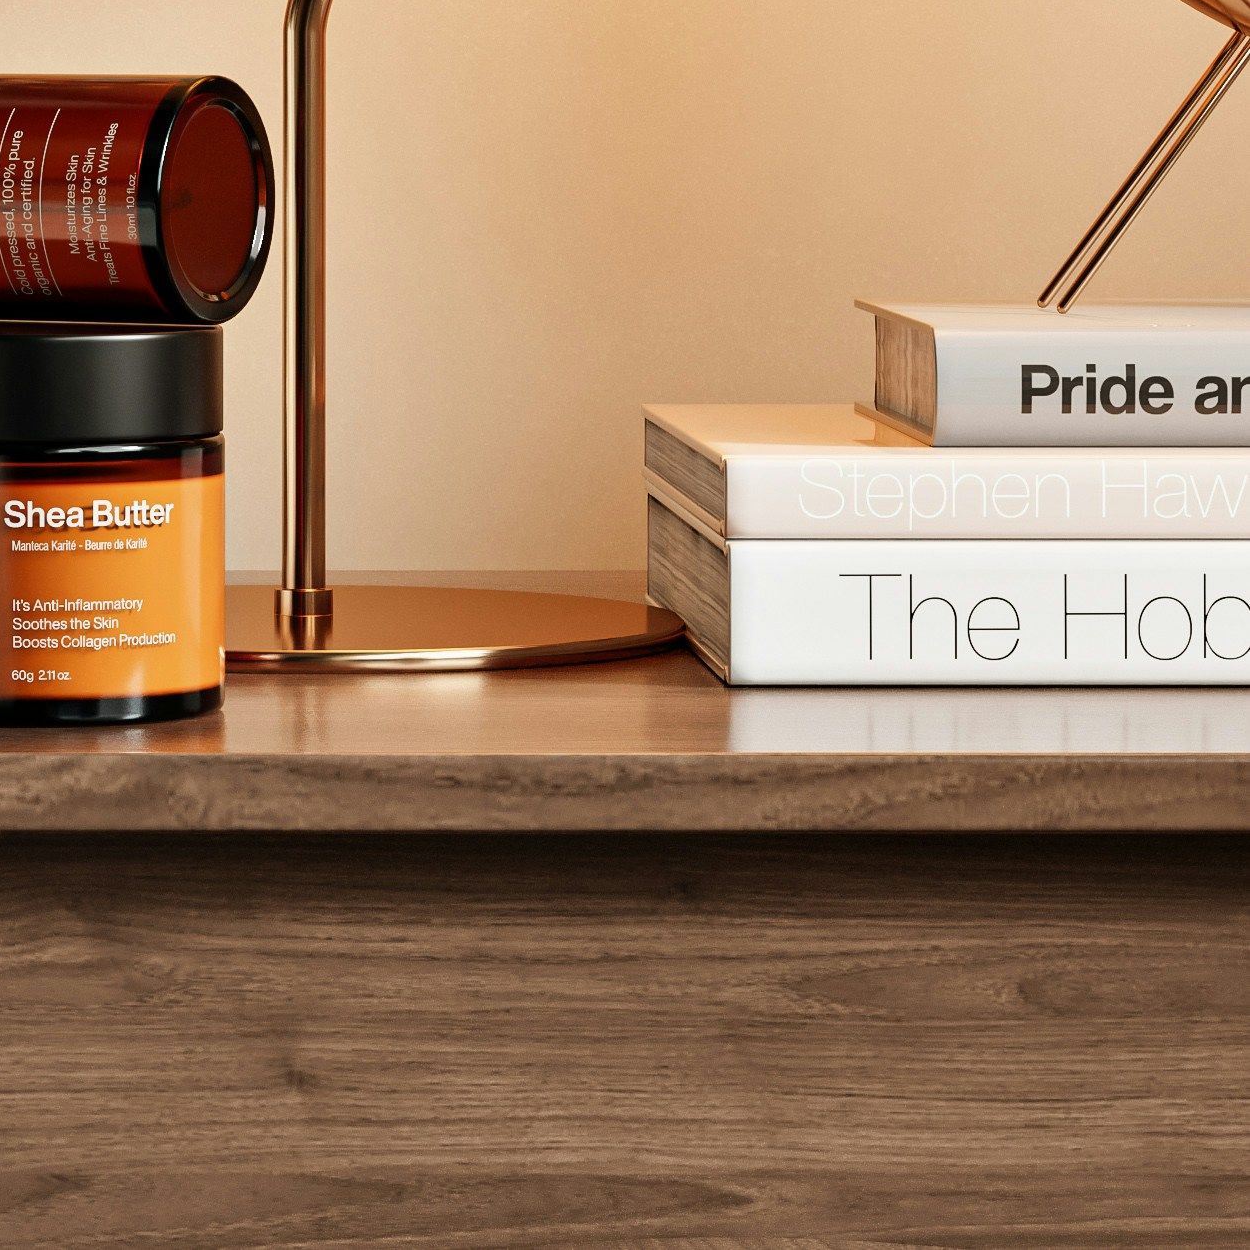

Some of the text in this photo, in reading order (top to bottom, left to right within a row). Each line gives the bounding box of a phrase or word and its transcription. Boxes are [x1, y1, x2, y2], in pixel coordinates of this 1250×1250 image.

[2, 130, 33, 295] Cold pressed, 100% pure
[21, 157, 51, 295] organic and certified.
[65, 155, 80, 254] Moisturizes Skin
[81, 147, 97, 262] Anti-Aging for Skin
[96, 122, 120, 284] Treats Fine Lines & Wrinkles
[127, 213, 137, 239] 30ml
[1021, 364, 1174, 415] Pride
[4, 499, 174, 528] Shea Butter
[798, 459, 1250, 531] Stephen Haw
[11, 540, 48, 551] Manteca
[51, 540, 76, 551] Karité
[85, 539, 112, 550] Beurre
[114, 539, 124, 549] de
[126, 537, 147, 549] Karité
[12, 598, 143, 612] It's Anti-Inflammatory
[12, 617, 119, 630] Soothes the Skin
[839, 574, 1250, 661] The Hob
[12, 632, 176, 650] Boosts Collagen Production
[11, 670, 34, 682] 60g
